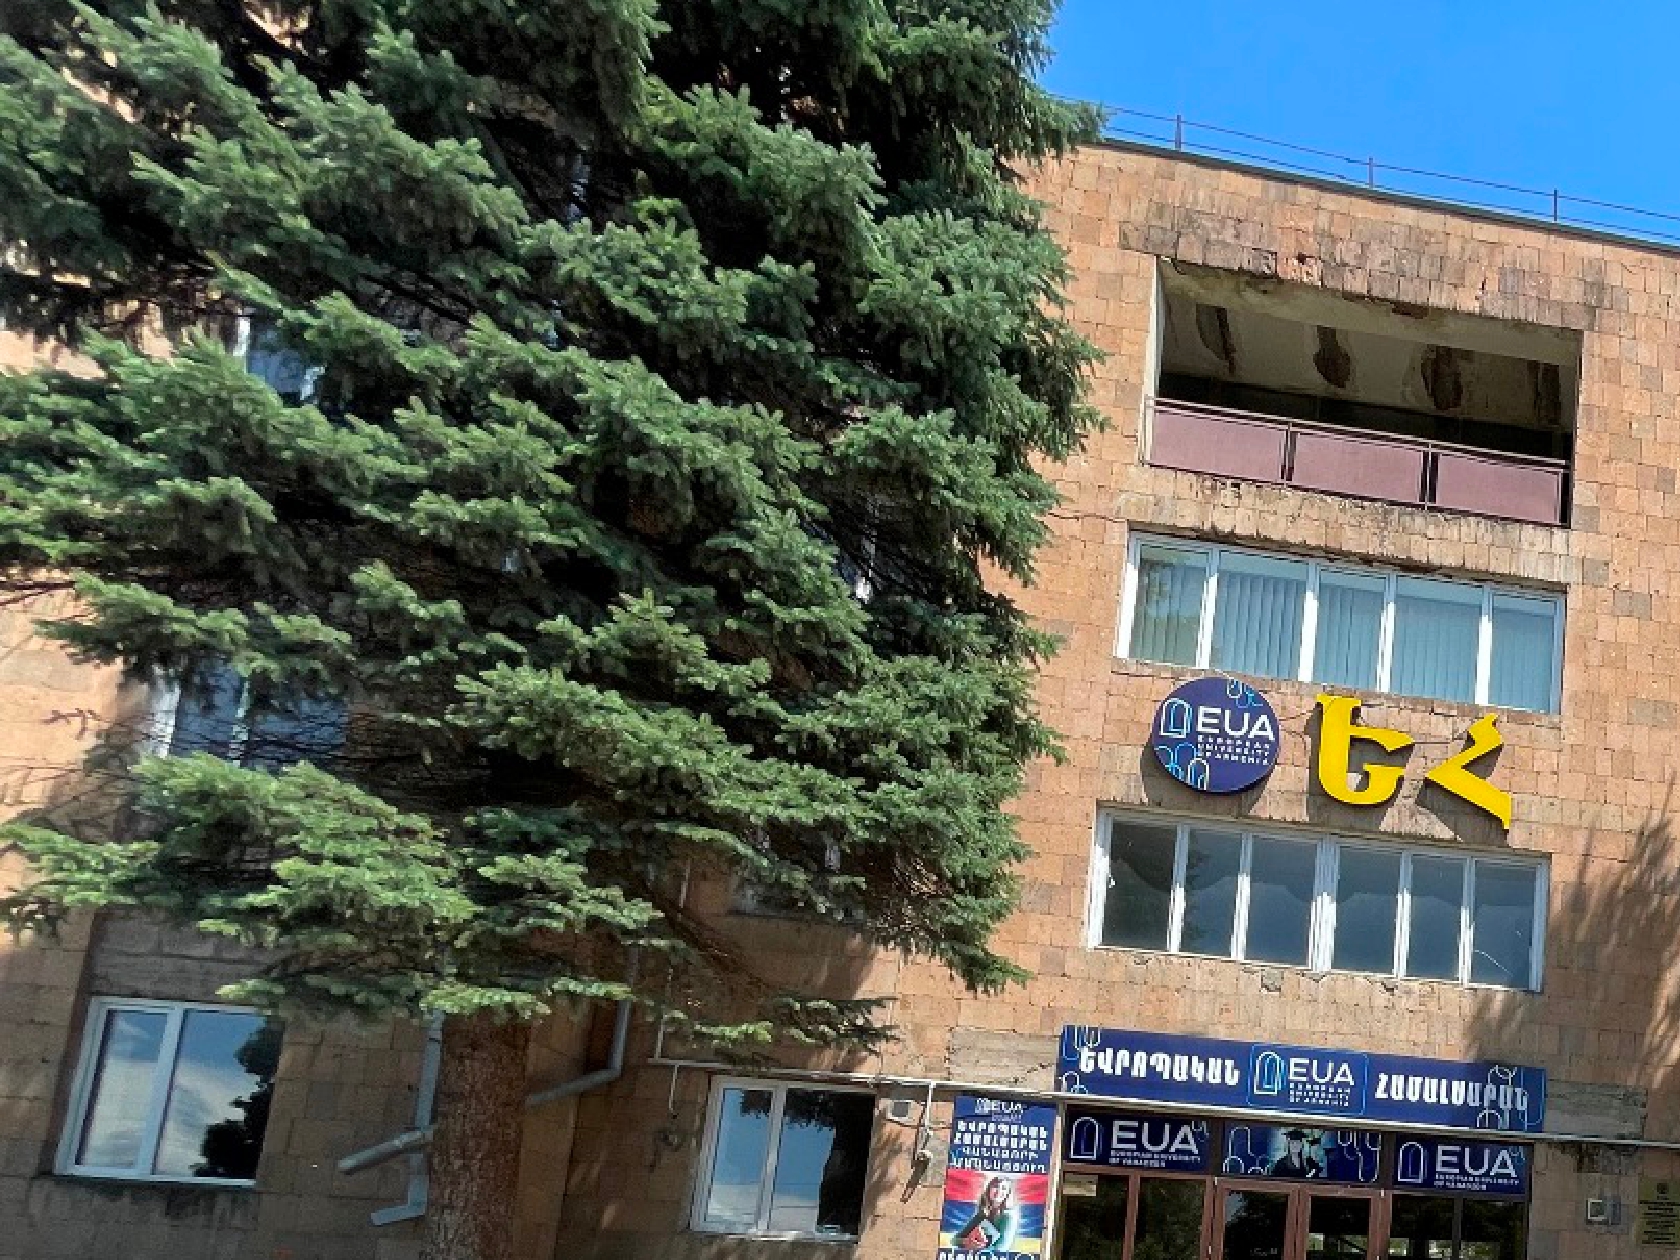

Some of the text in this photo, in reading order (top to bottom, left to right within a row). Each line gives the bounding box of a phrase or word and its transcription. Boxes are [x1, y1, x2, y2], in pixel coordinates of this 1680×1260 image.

[1197, 705, 1275, 741] EUA
[1079, 1047, 1240, 1085] ԵՎՐՈՊԱԿԱՆ
[1288, 1057, 1354, 1085] EUA
[1375, 1072, 1529, 1111] ՀԱՄԱԼՍԱՐԱՆ
[954, 1132, 1048, 1151] ՀԱՄԱԼՍԱՐԱՆ
[957, 1120, 1048, 1139] ԵՎՐՈՊԱԿԱՆ
[1111, 1120, 1199, 1155] EUA
[1434, 1144, 1518, 1177] EUA
